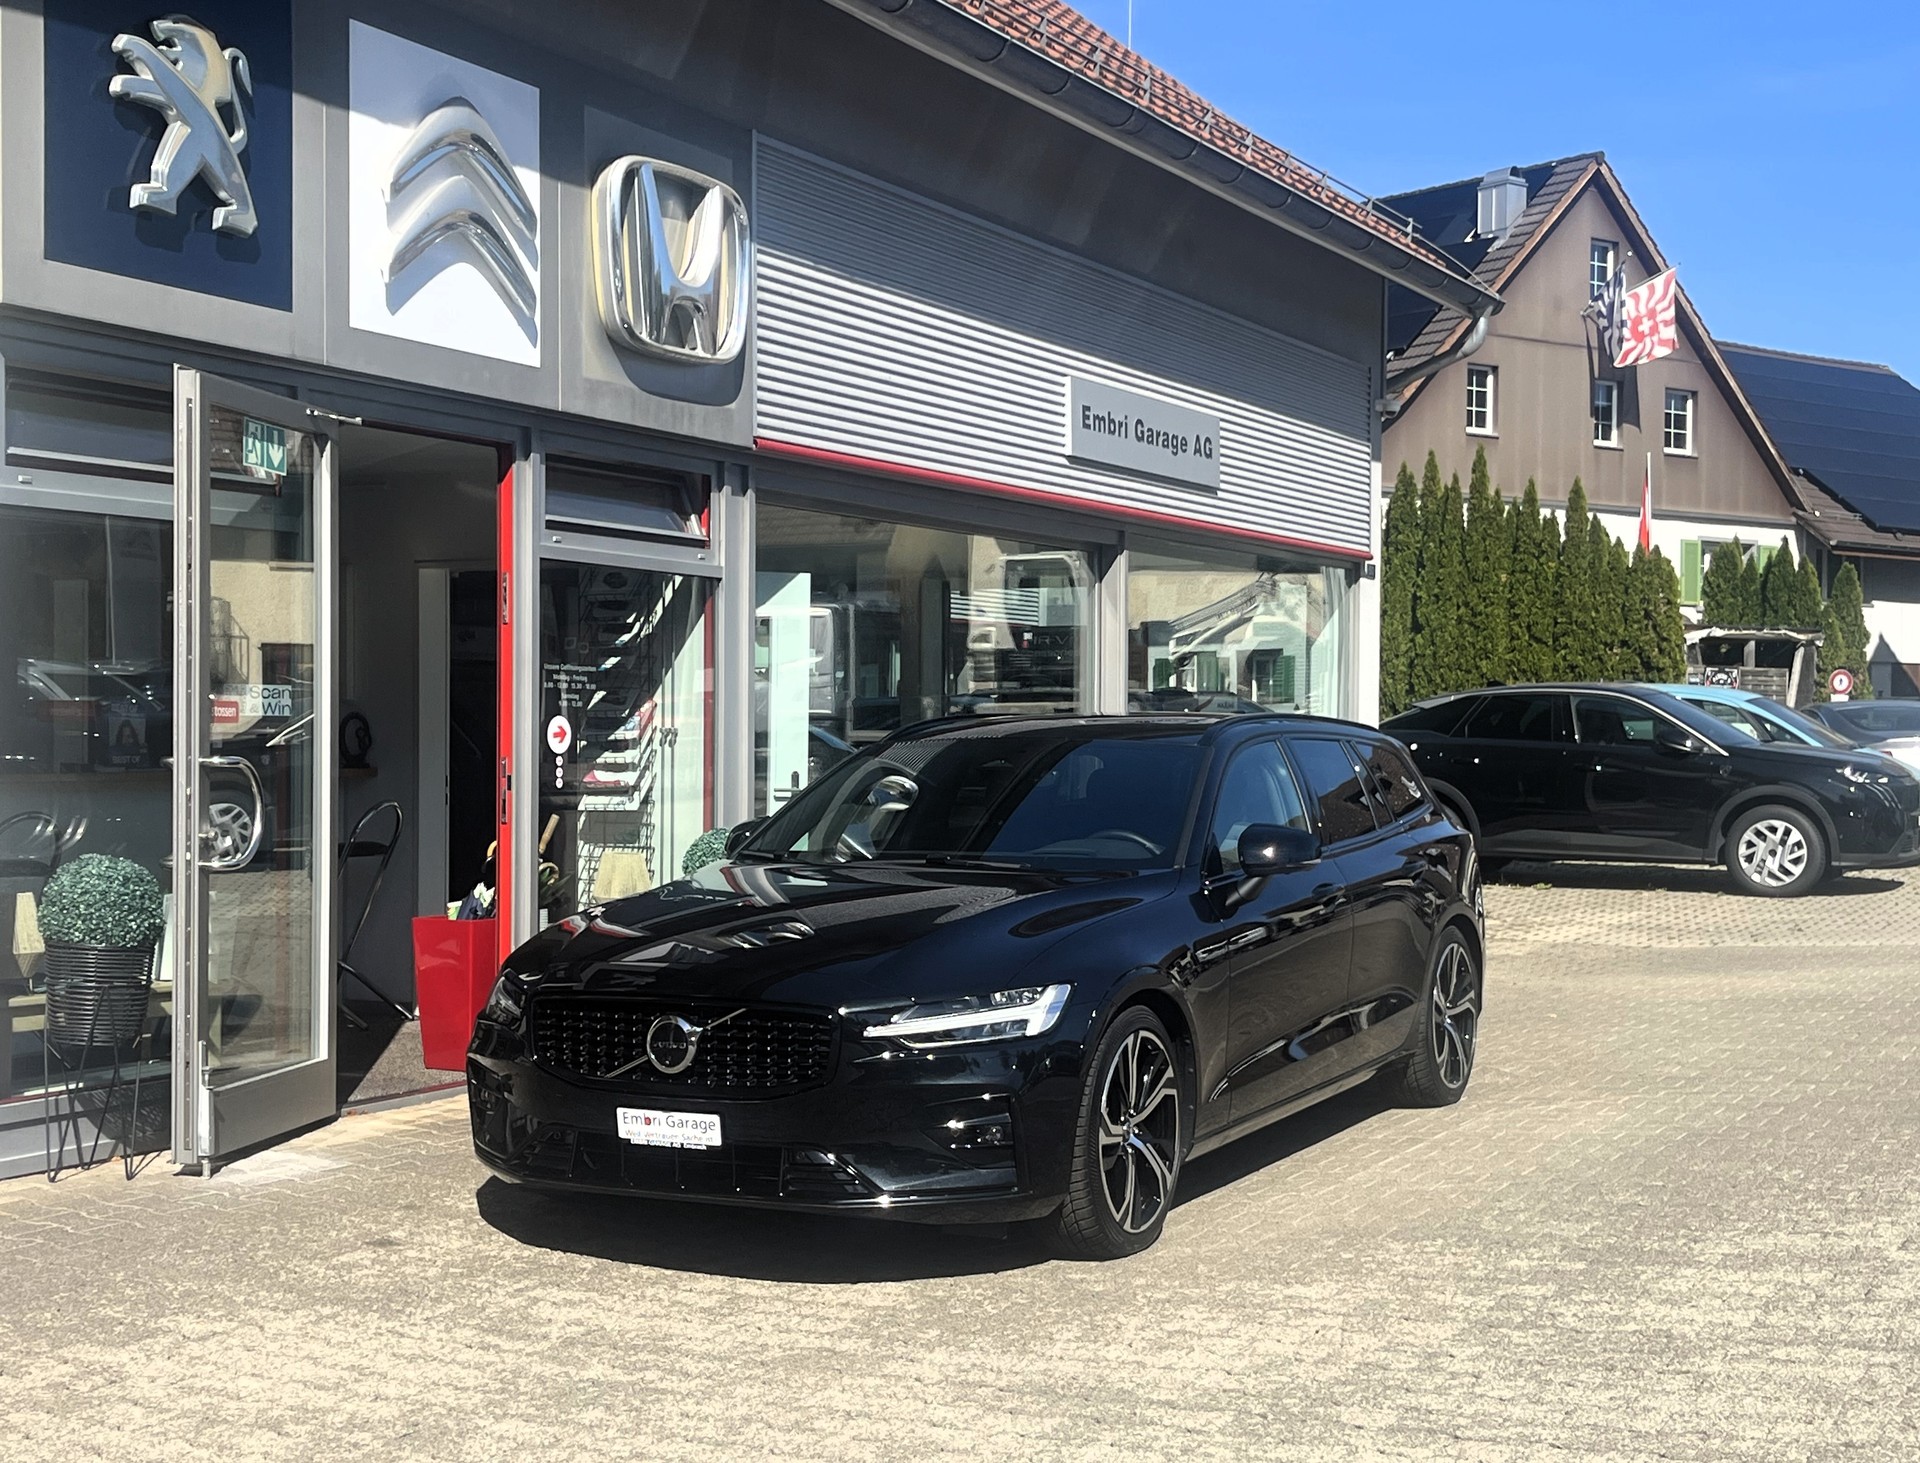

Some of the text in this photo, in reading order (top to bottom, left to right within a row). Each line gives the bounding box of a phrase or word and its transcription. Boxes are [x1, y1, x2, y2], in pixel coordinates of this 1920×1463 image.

[1081, 404, 1213, 460] Embri Garage AG
[249, 685, 292, 700] Scan
[249, 700, 292, 715] & Win
[622, 1111, 716, 1134] Embri Garage
